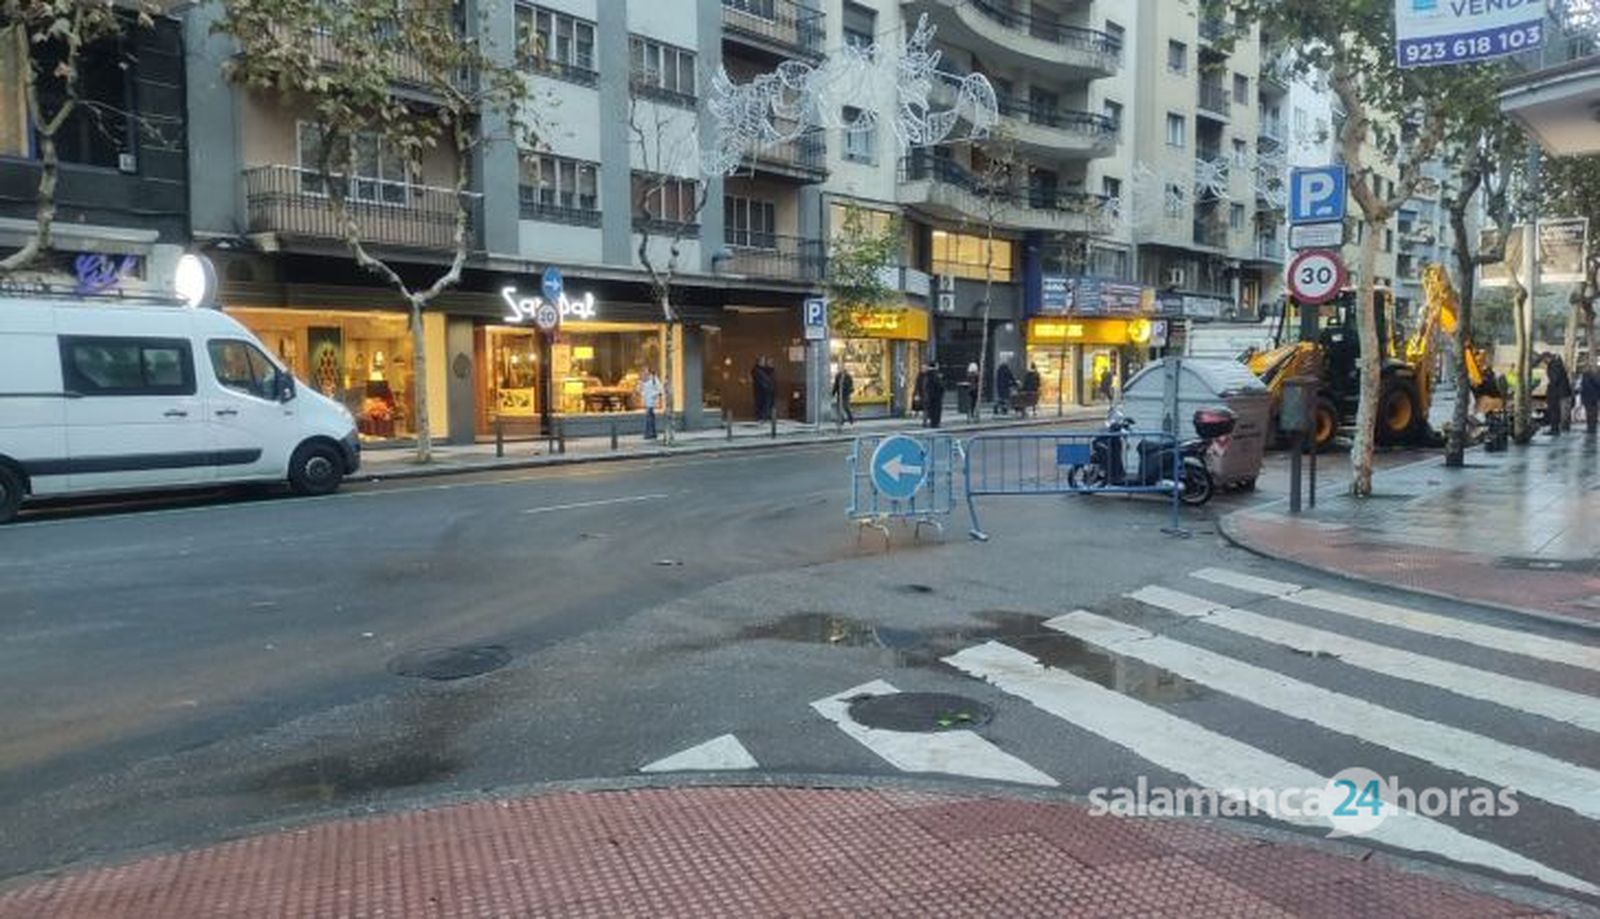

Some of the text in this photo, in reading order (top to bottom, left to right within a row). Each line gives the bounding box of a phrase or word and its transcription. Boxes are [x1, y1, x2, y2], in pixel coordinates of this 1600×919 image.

[1450, 0, 1541, 17] VEND
[1406, 26, 1541, 61] 923 618 103
[1301, 173, 1335, 217] P
[1301, 267, 1332, 284] 30
[808, 303, 821, 324] P
